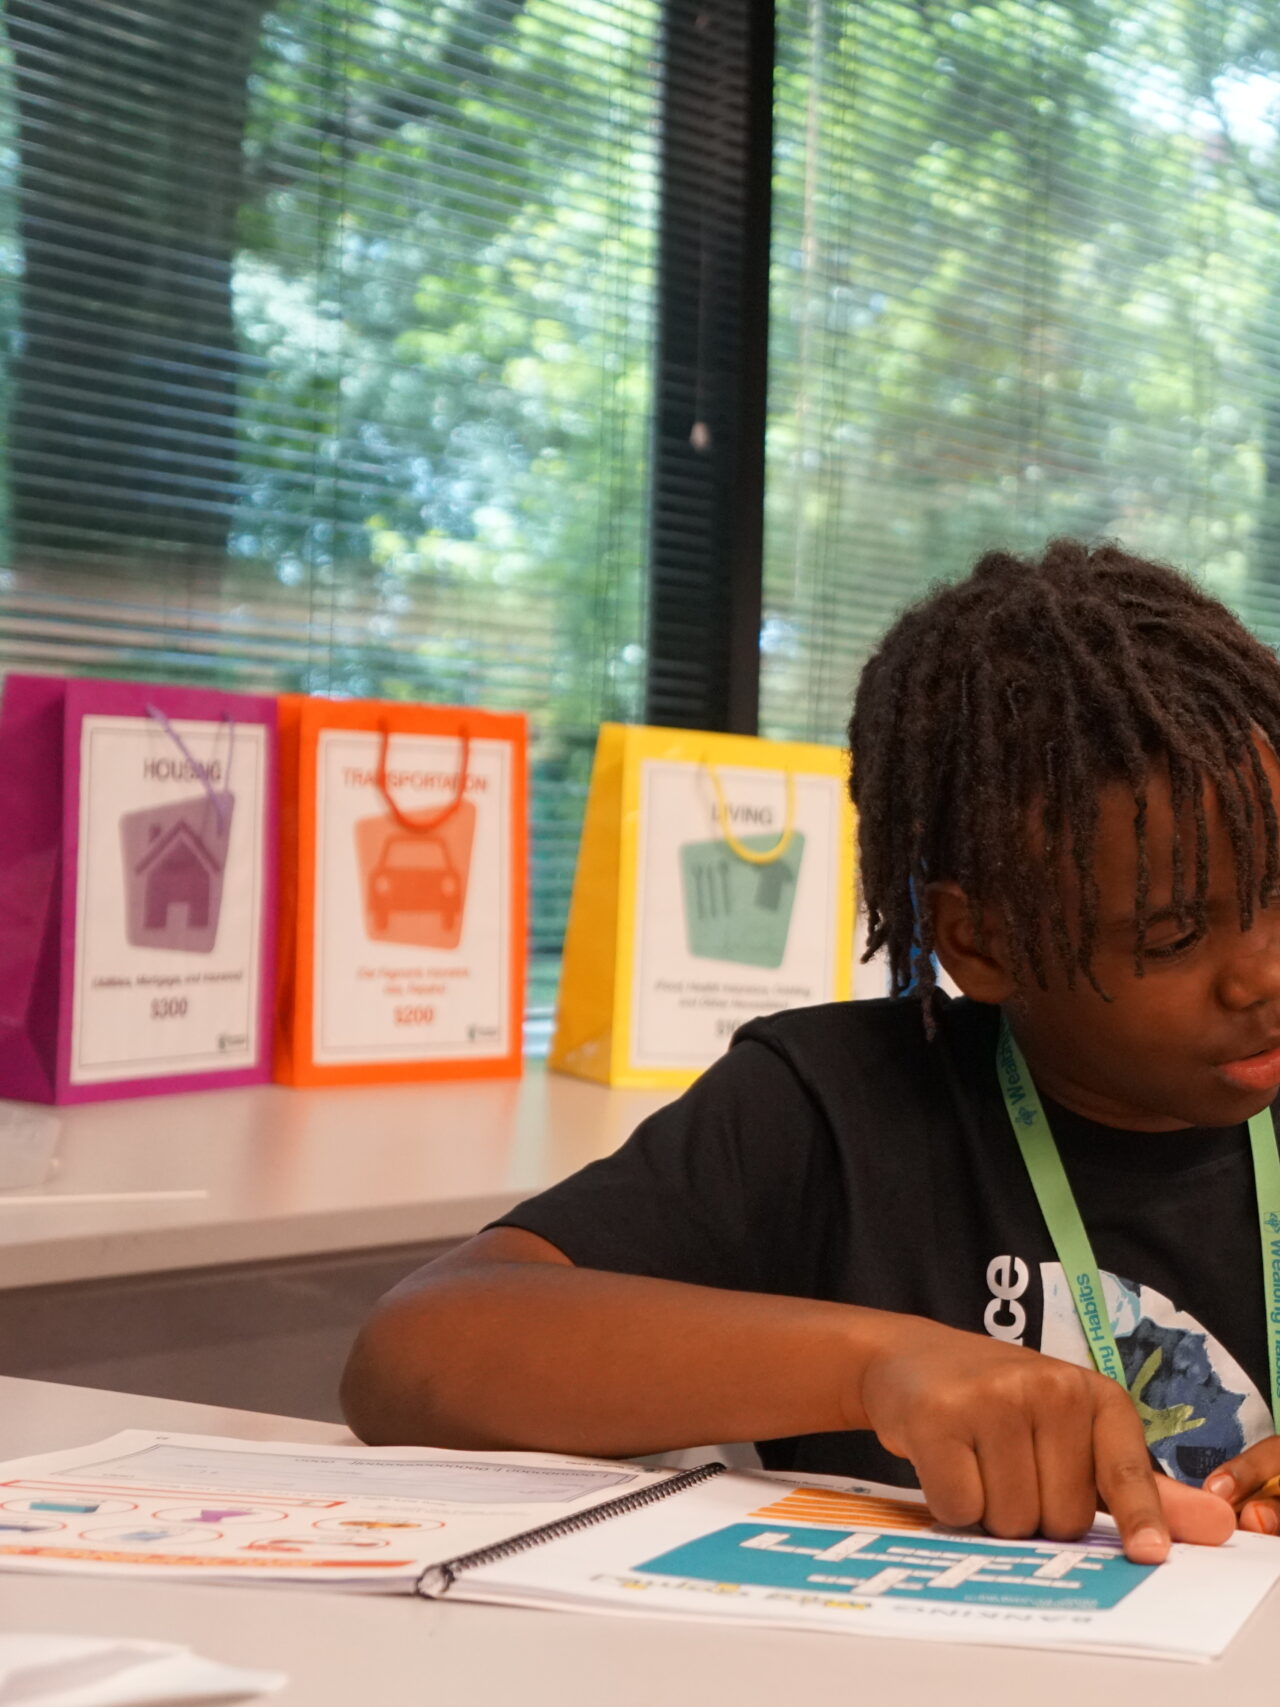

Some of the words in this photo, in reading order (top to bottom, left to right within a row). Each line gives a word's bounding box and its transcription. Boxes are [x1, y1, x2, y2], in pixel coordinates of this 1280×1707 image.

[143, 757, 222, 782] HOUSNG
[341, 766, 488, 792] TRASPORTATON
[710, 802, 774, 826] LVING
[151, 997, 189, 1020] $300
[1075, 1272, 1105, 1342] Habits
